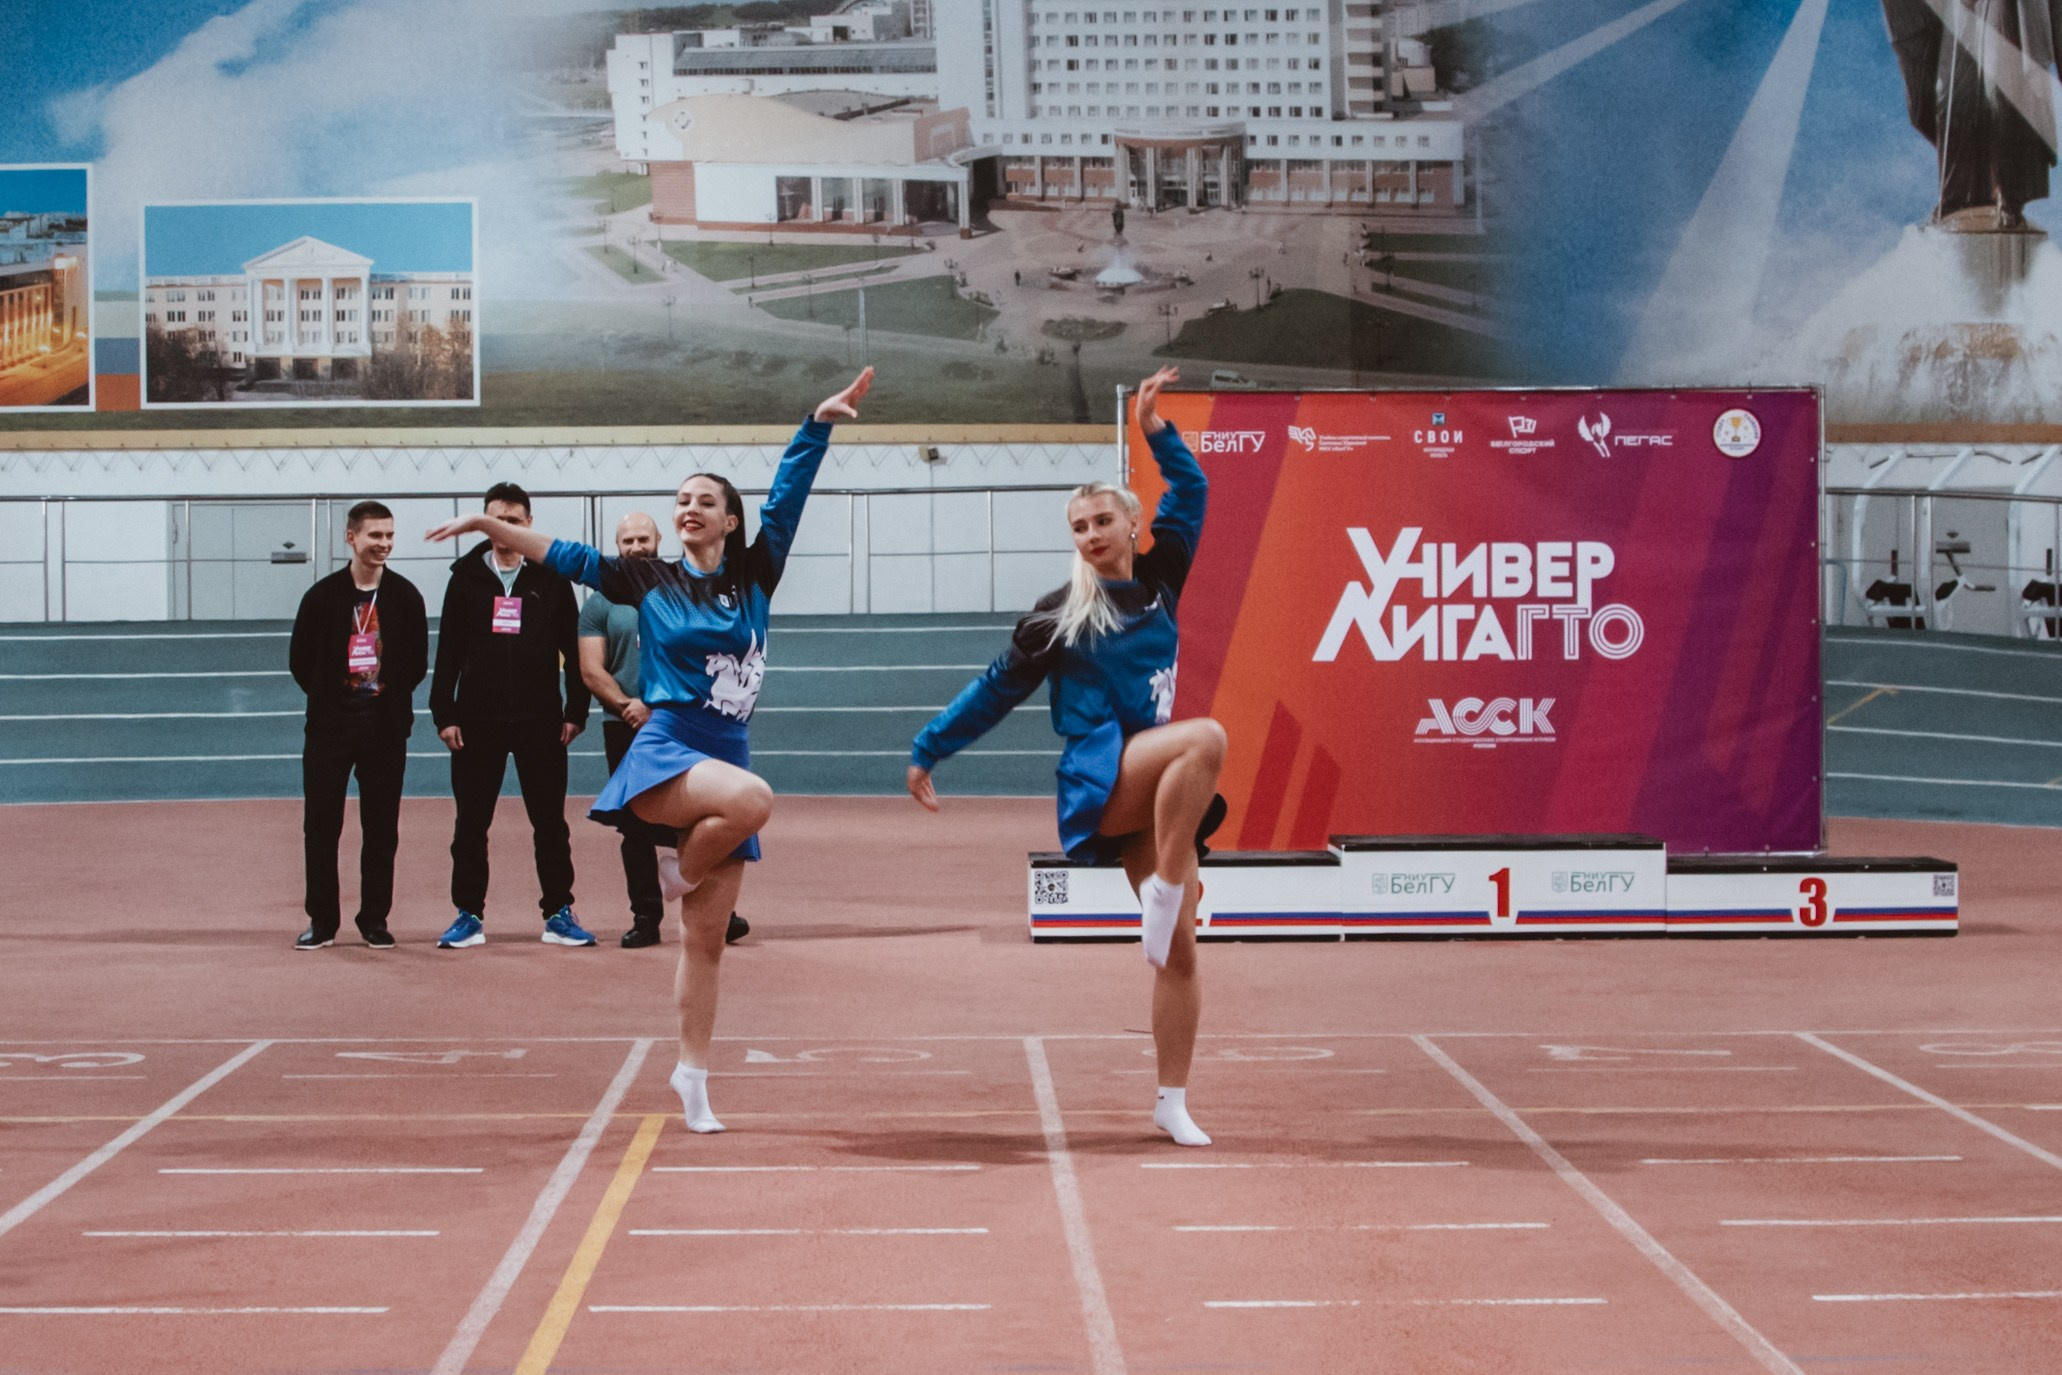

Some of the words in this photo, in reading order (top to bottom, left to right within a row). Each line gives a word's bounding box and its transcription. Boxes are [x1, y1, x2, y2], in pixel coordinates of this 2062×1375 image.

[1200, 434, 1266, 452] БелГУ
[1213, 432, 1237, 440] НИУ
[1413, 430, 1463, 443] СВОИ
[1614, 435, 1674, 446] ПЕГАС
[1414, 697, 1557, 736] АССК
[1391, 876, 1456, 894] БелГУ
[1403, 873, 1427, 881] НИУ
[1570, 874, 1635, 893] БелГУ
[1488, 867, 1510, 918] 1
[1799, 877, 1828, 928] 3
[335, 1048, 528, 1064] 4
[745, 1048, 933, 1063] 5
